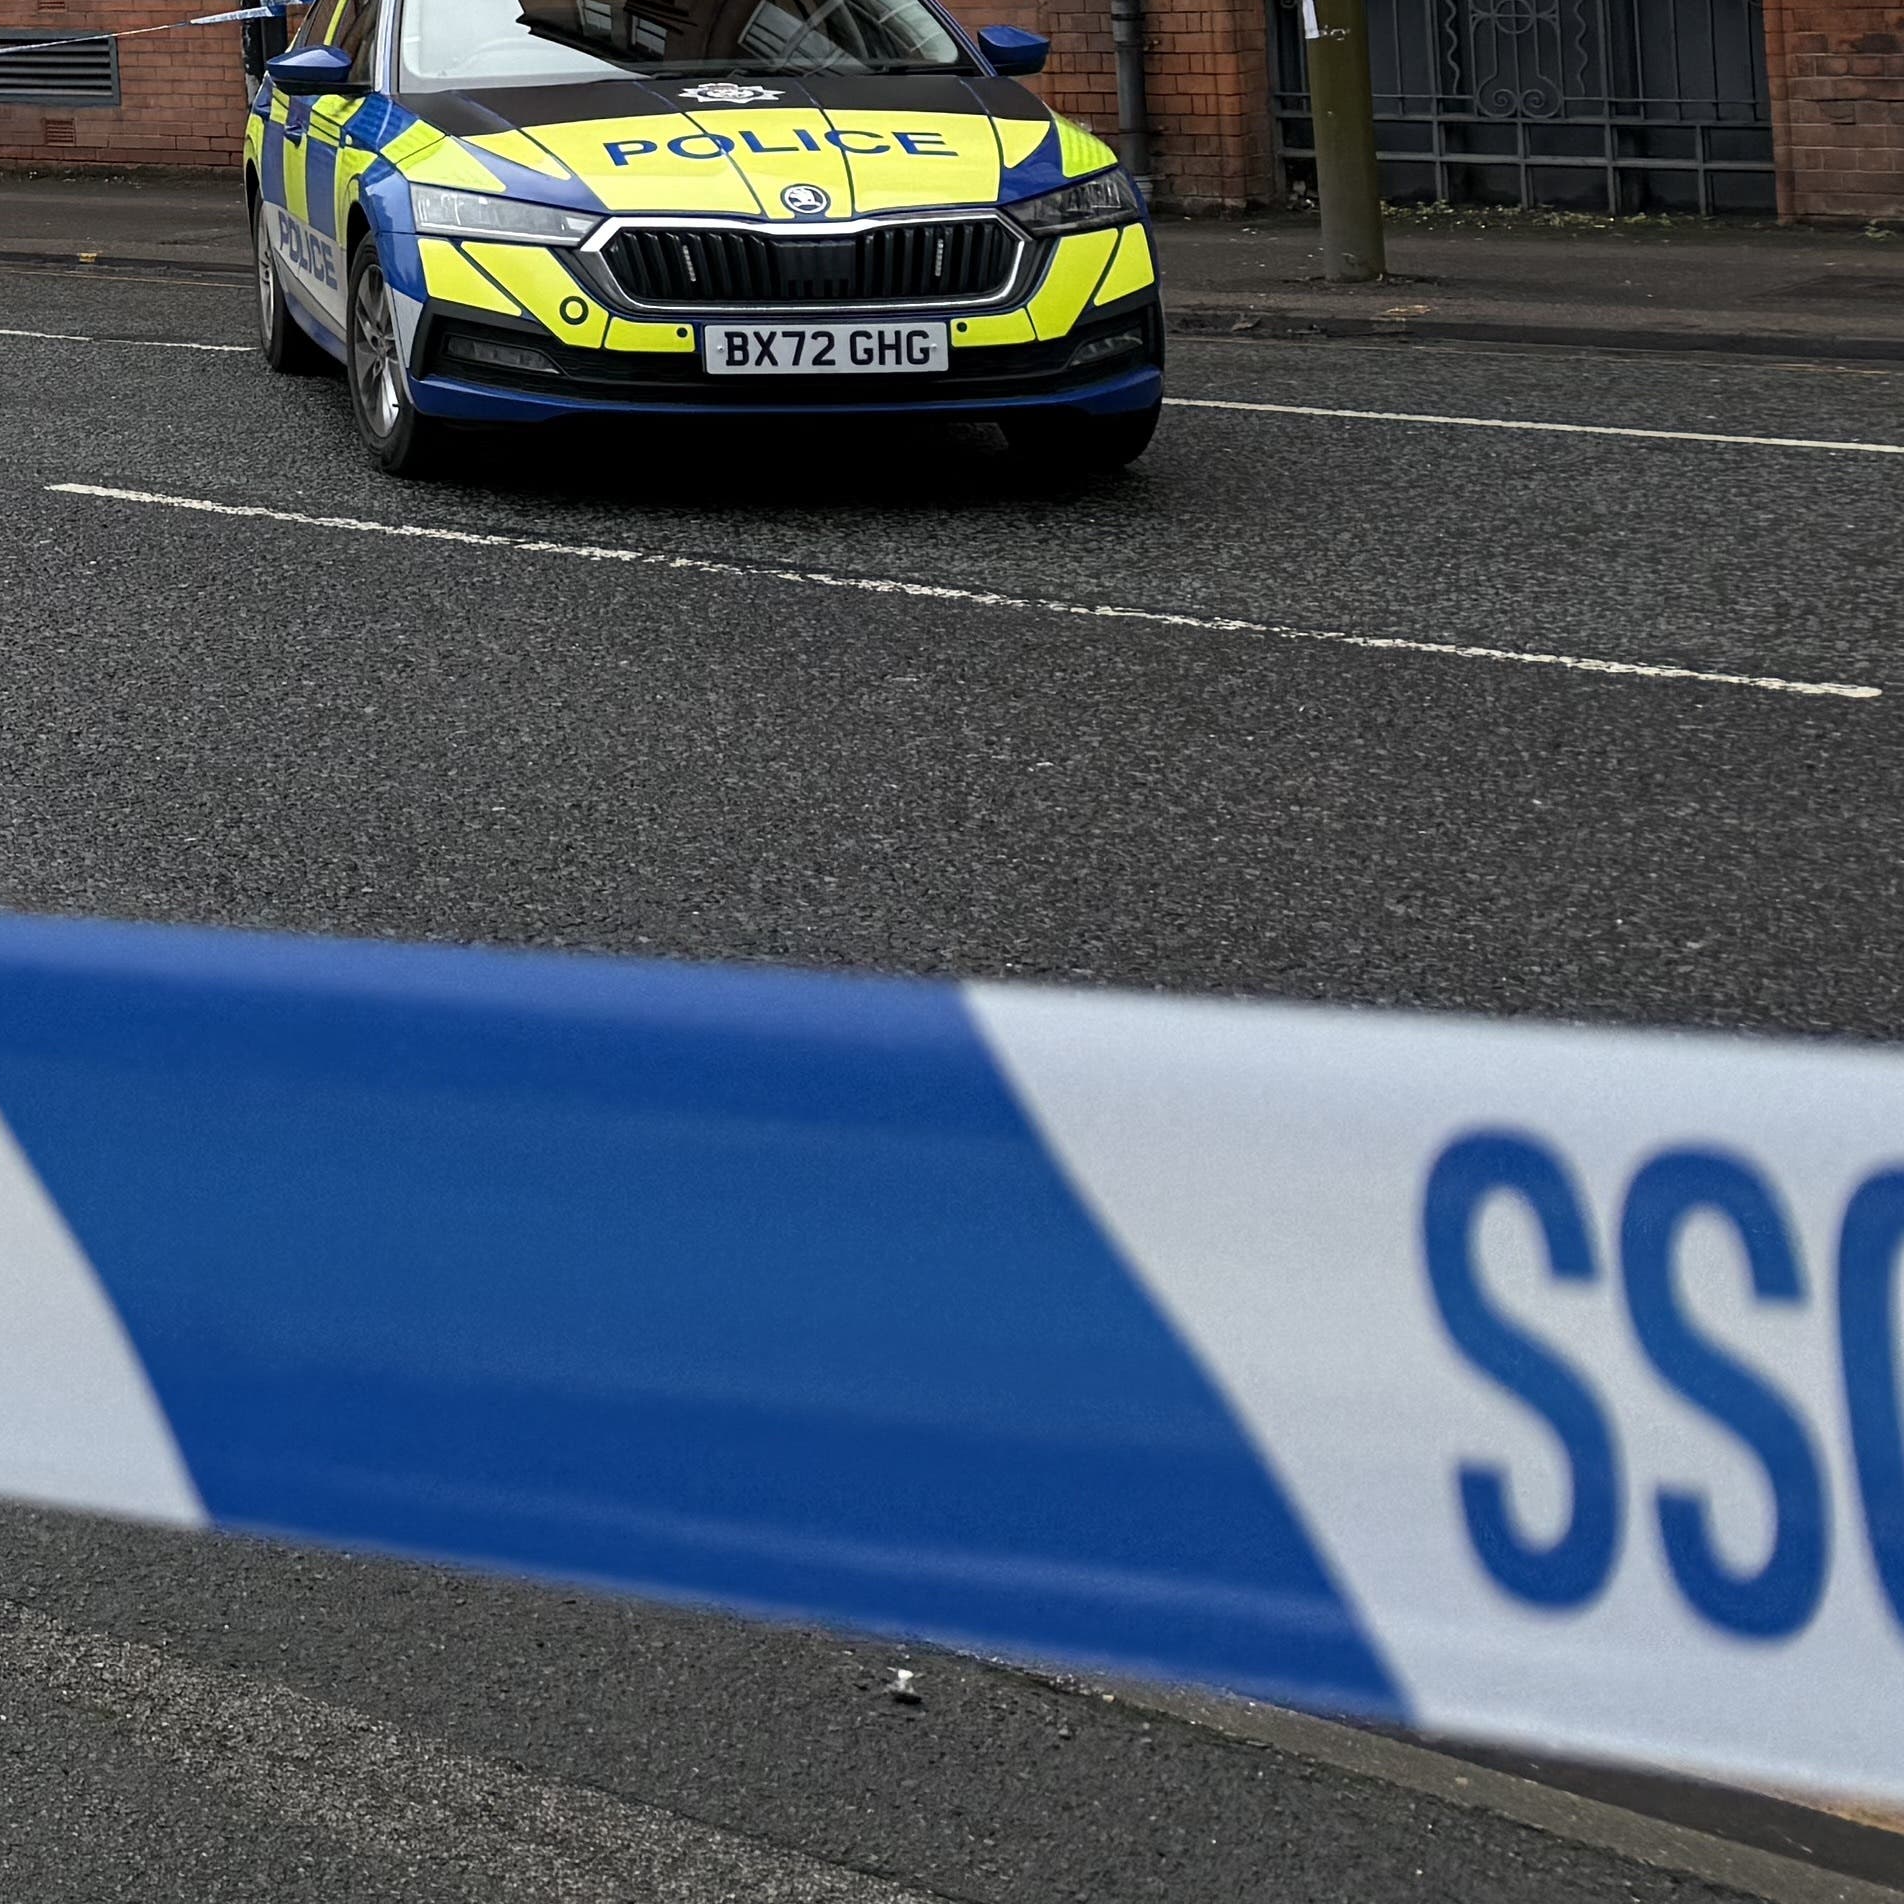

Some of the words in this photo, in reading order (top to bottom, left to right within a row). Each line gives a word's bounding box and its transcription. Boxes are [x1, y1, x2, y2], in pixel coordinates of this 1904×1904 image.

[603, 128, 959, 167] POLICE
[278, 210, 338, 291] POLICE
[724, 330, 837, 367] BX72
[849, 329, 931, 366] GHG
